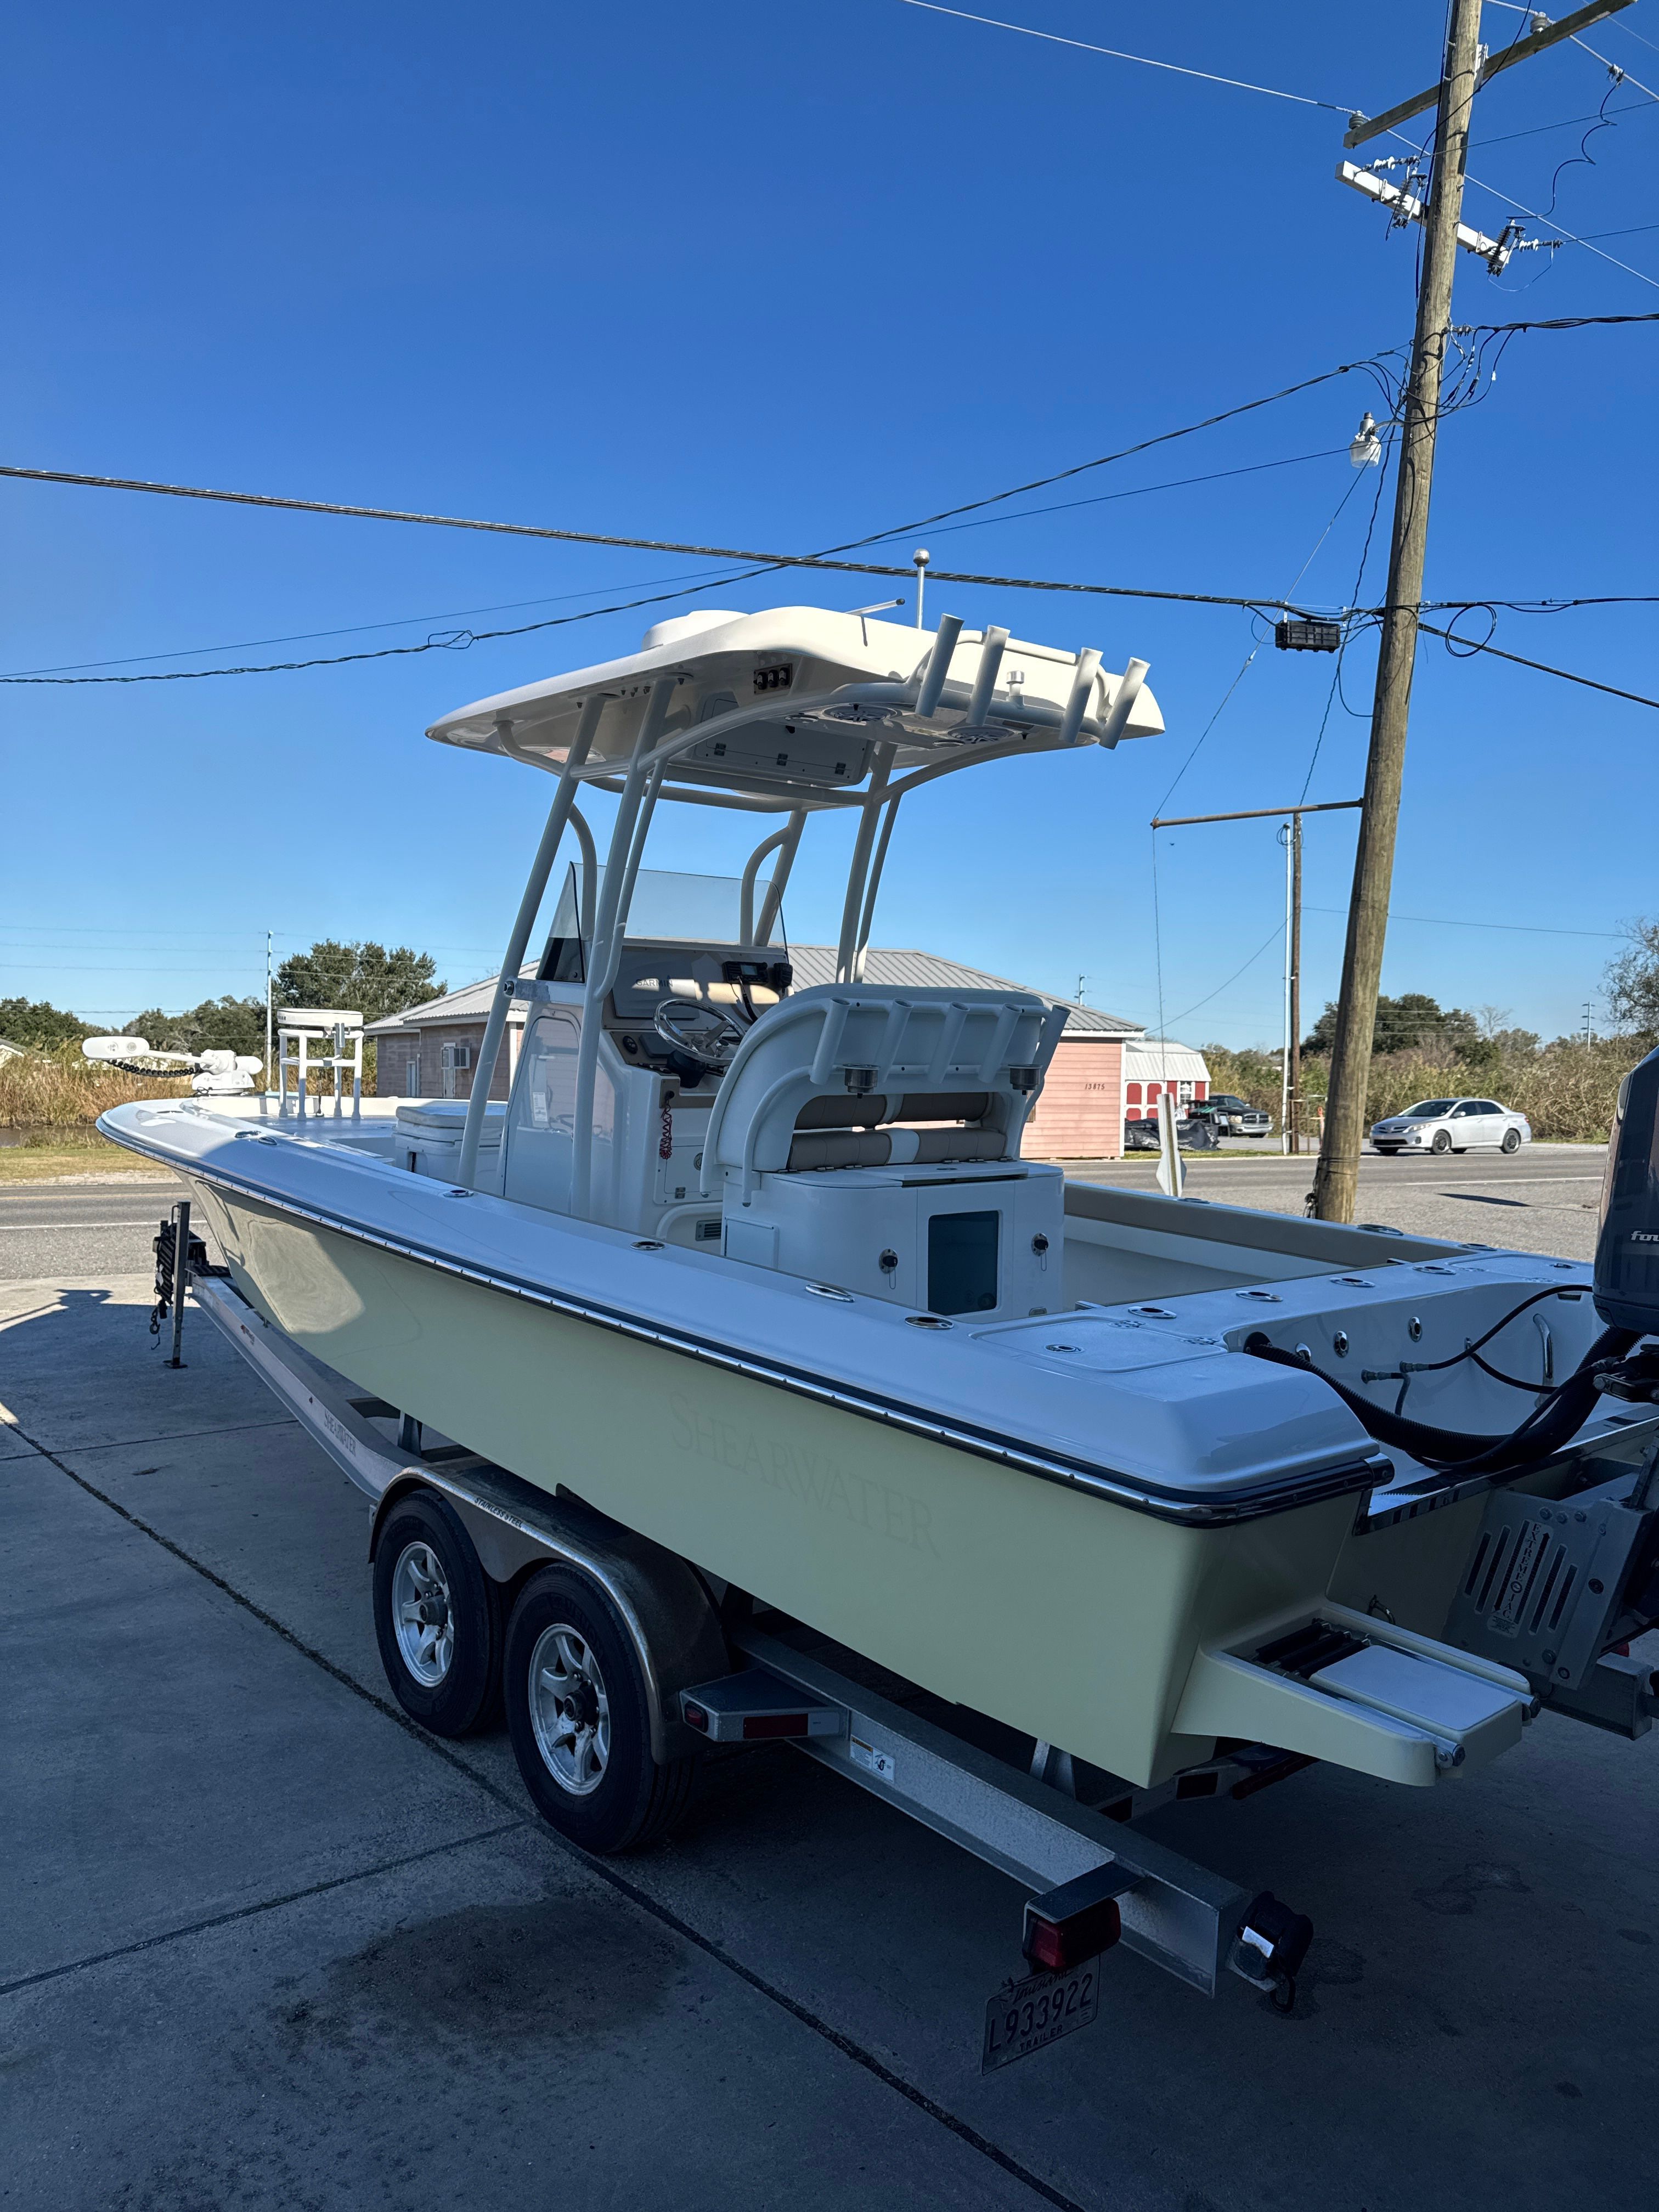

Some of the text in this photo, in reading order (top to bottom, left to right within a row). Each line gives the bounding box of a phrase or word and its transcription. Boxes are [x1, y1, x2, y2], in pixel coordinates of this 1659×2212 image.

[636, 978, 673, 987] GARMIN
[670, 1391, 942, 1560] SHEARWATER
[475, 1497, 523, 1528] STAINLESS STEEL
[1516, 1522, 1541, 1581] EXTREME
[989, 1973, 1093, 2052] L933922
[1019, 2024, 1063, 2051] TRAILER
